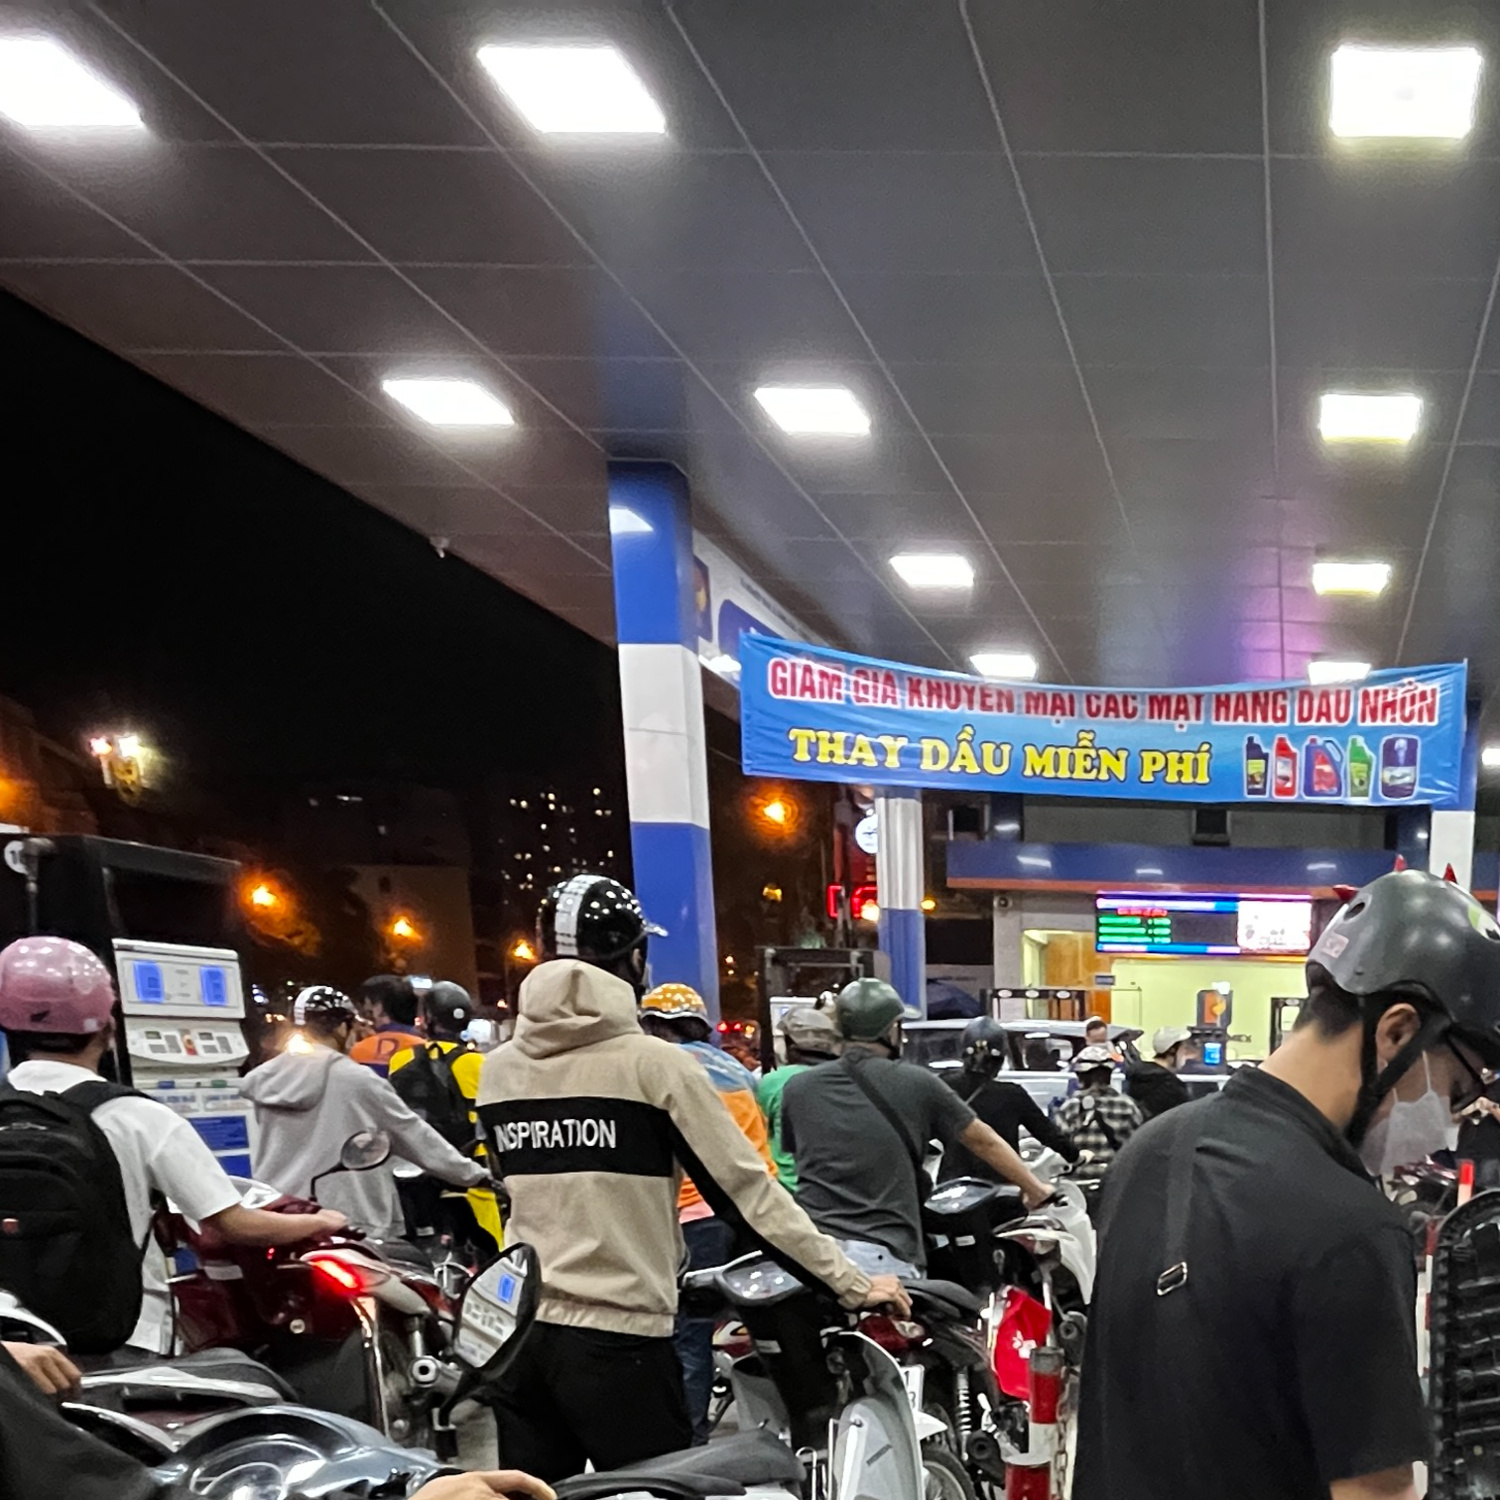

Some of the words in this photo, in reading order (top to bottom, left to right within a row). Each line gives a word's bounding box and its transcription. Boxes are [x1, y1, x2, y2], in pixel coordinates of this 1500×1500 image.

[787, 727, 909, 769] THAY
[919, 724, 1013, 775] DẦU
[1022, 729, 1130, 782] MIỄN
[1139, 742, 1213, 784] PHÍ
[493, 1118, 617, 1153] NSPIRATION
